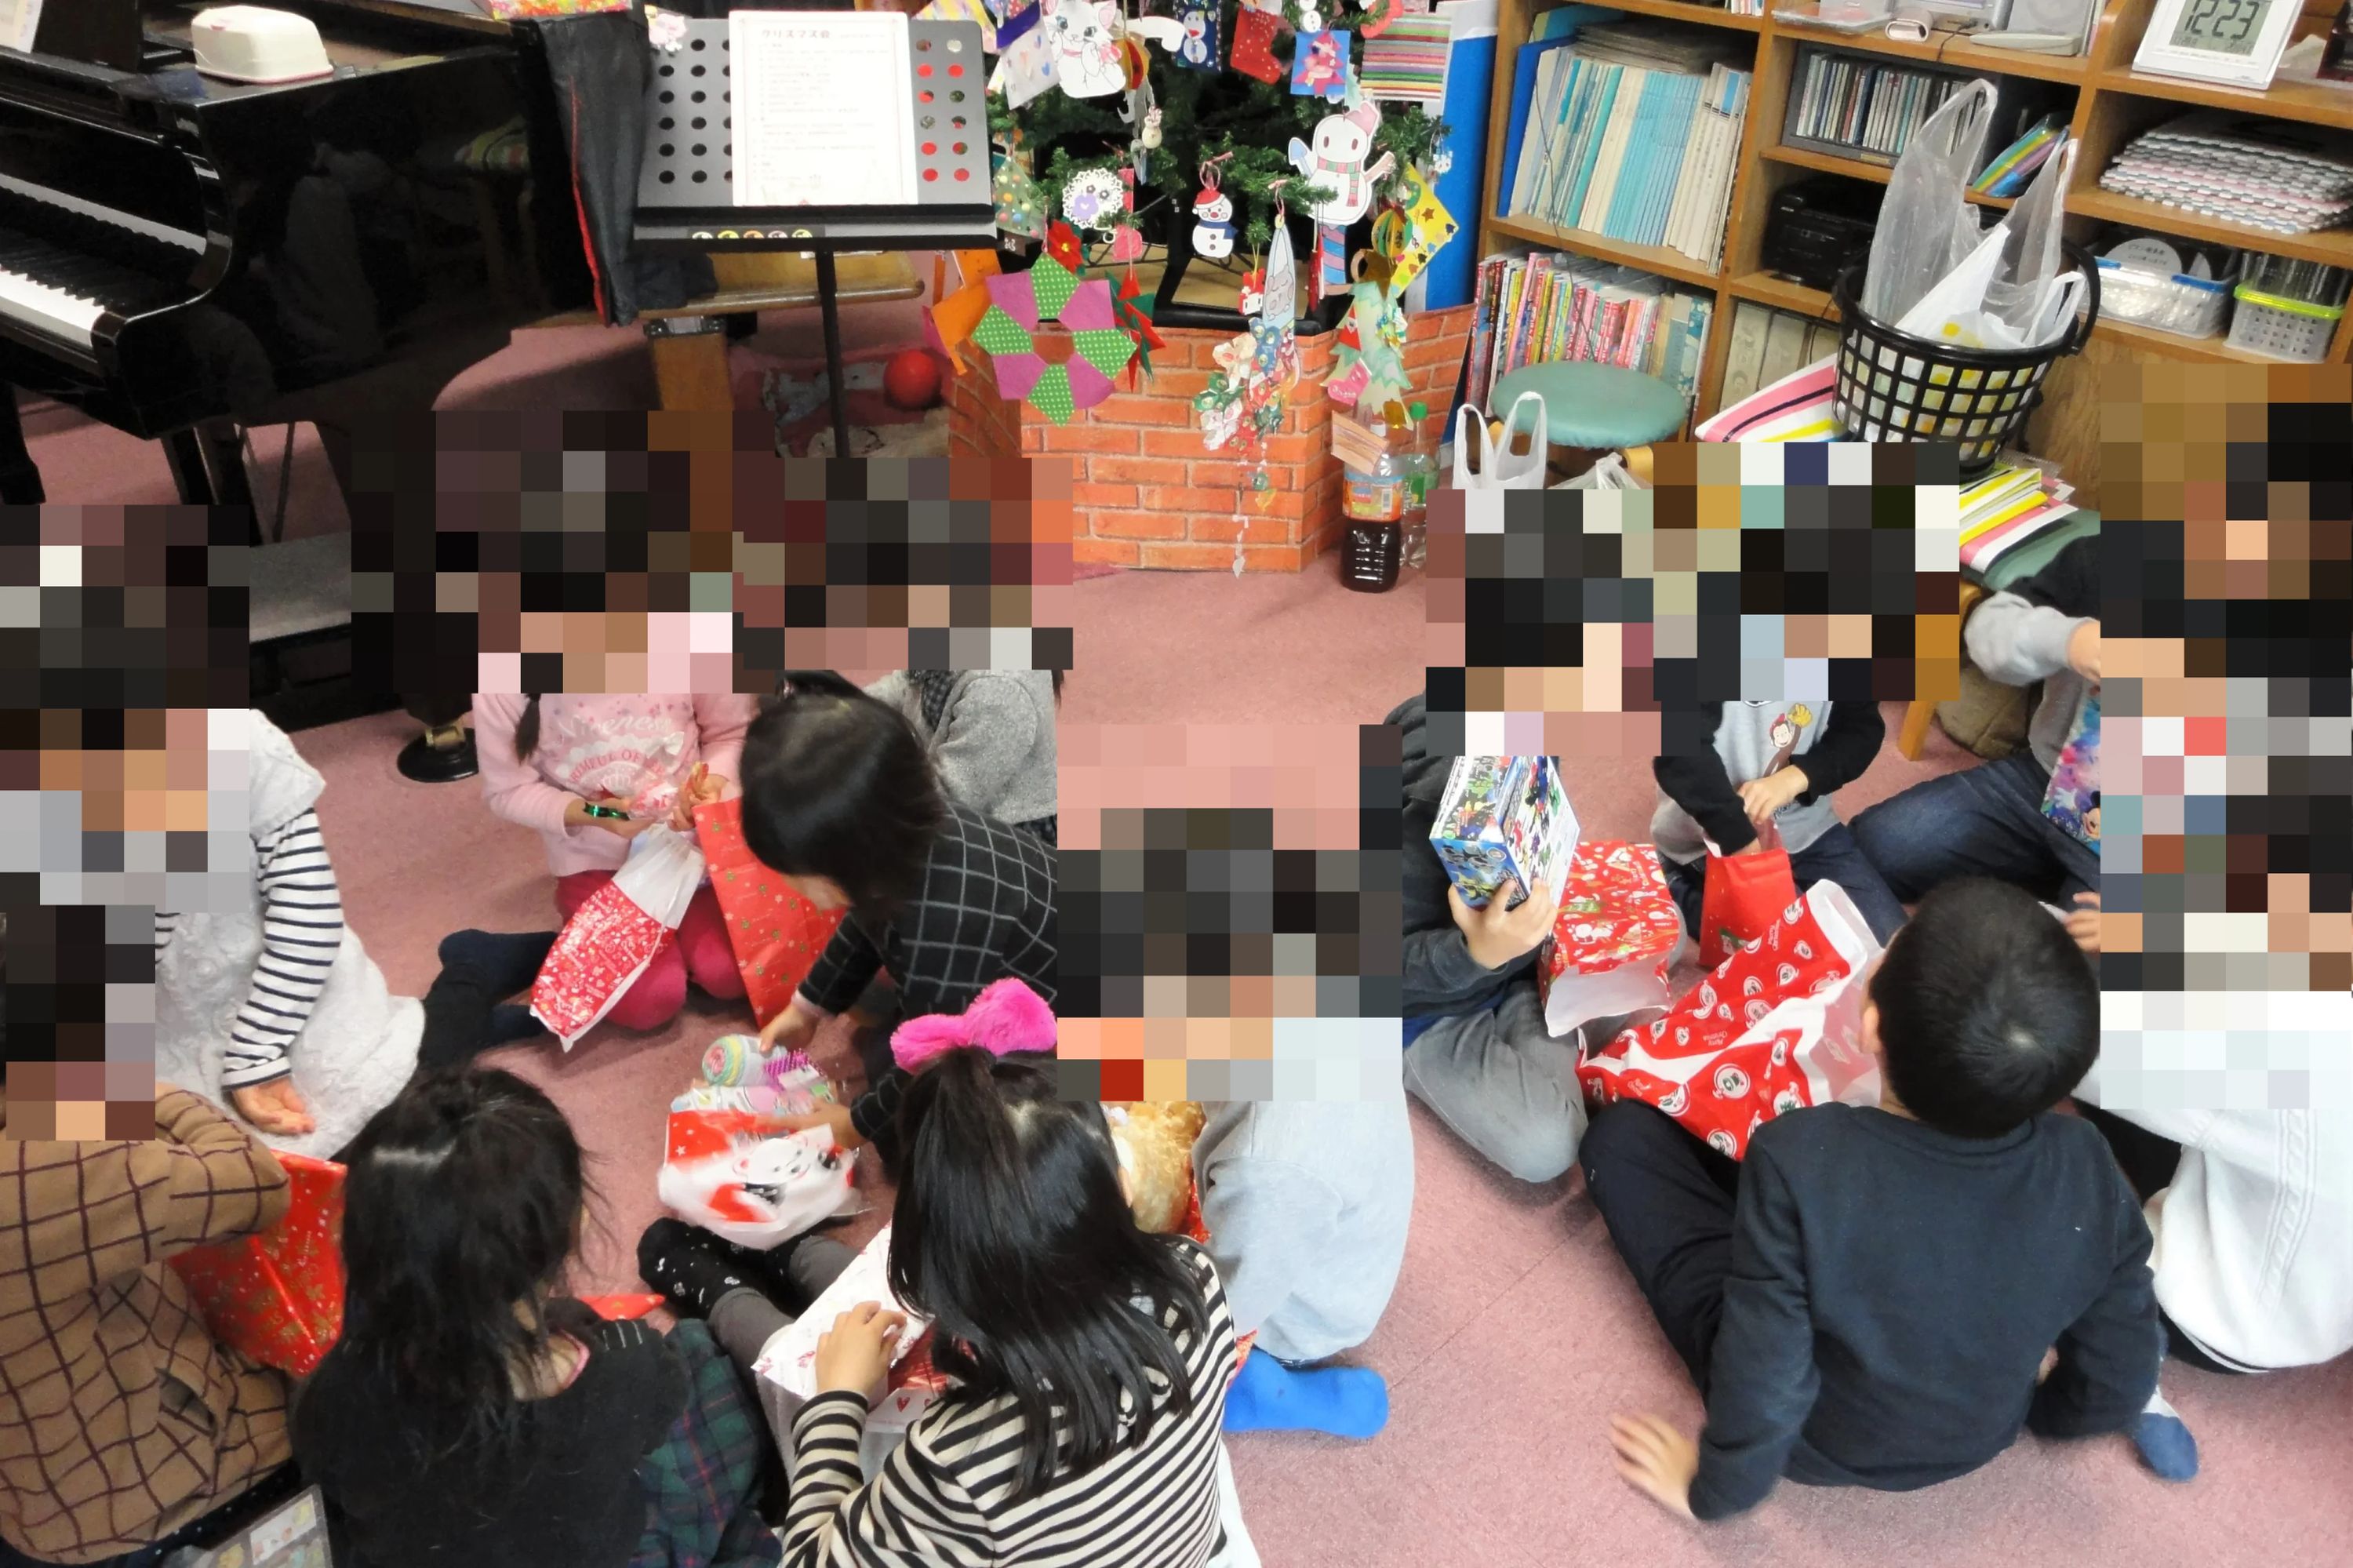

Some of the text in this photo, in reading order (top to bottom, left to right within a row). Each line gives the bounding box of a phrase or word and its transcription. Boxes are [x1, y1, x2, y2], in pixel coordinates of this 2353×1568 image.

[762, 29, 831, 39] クリスマス会
